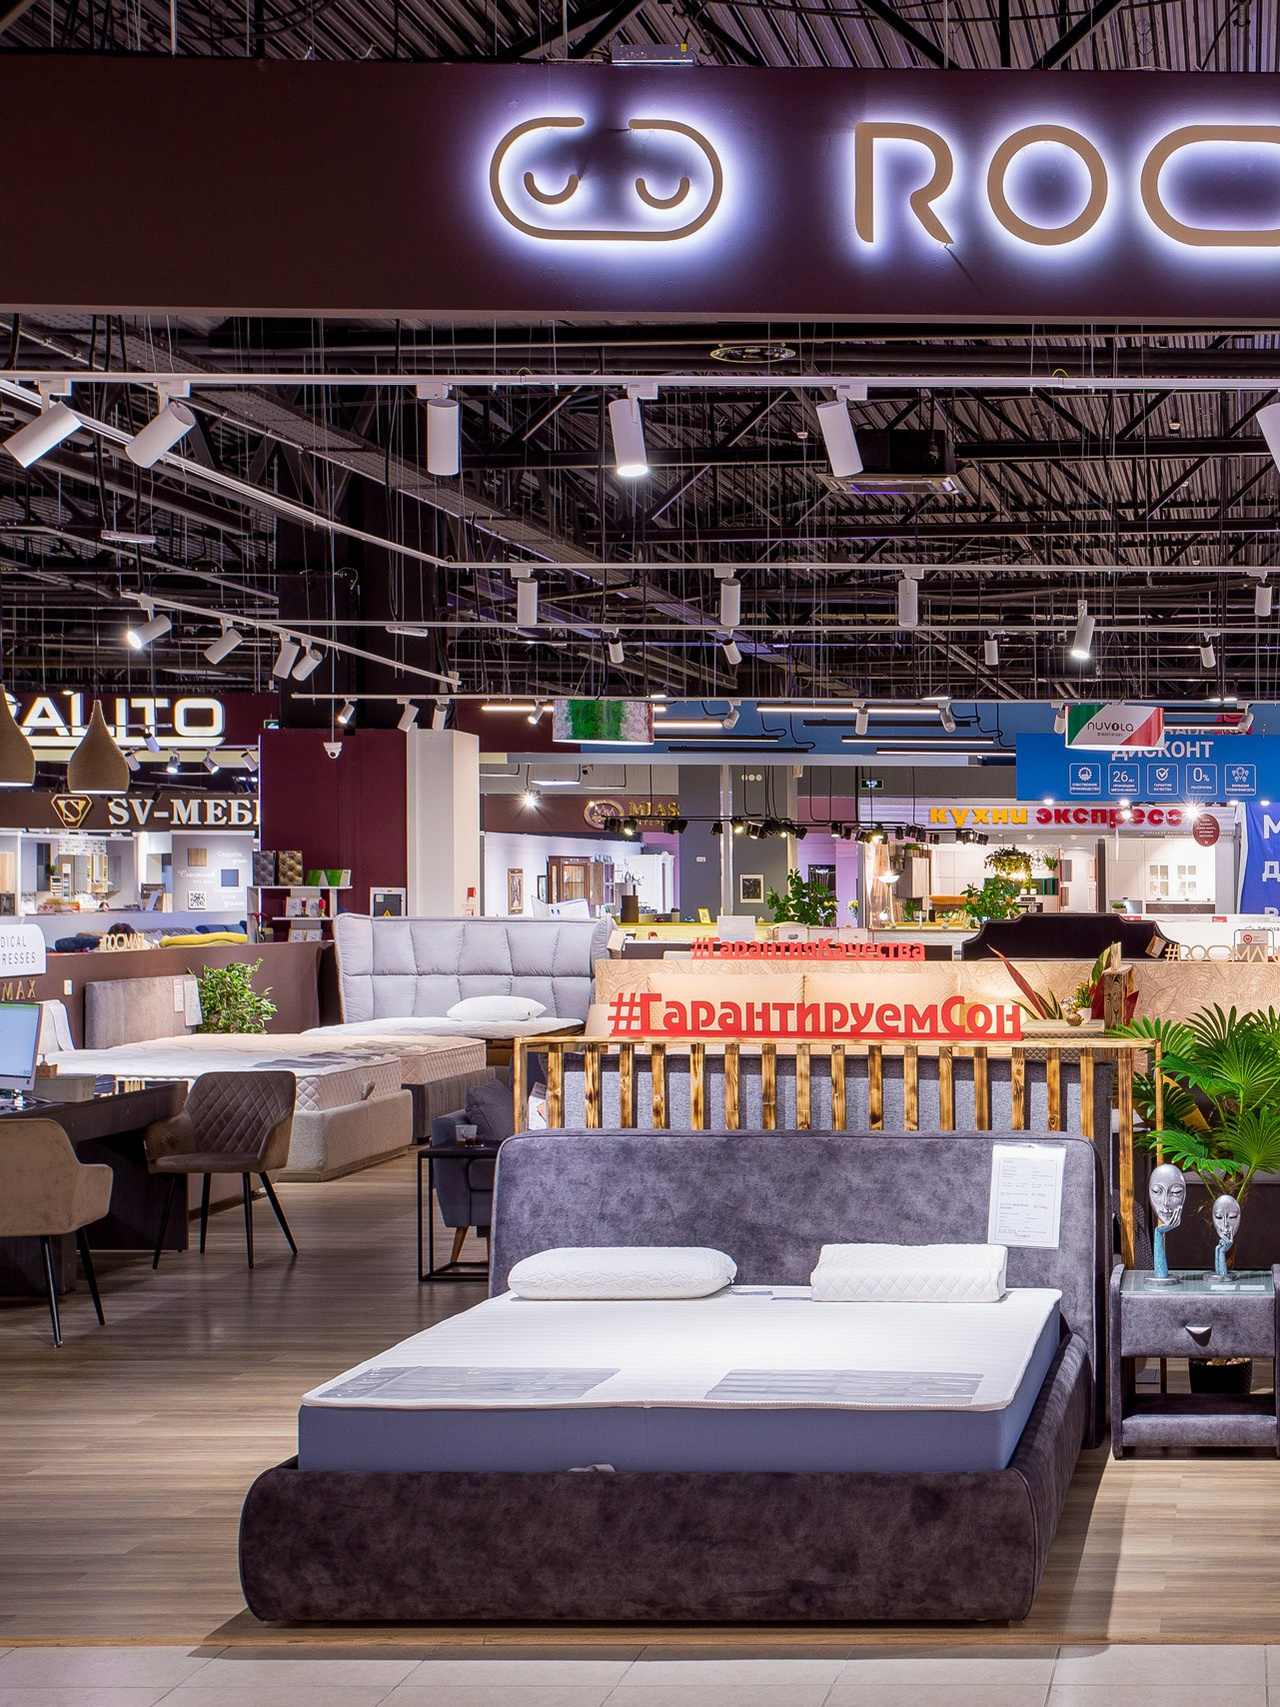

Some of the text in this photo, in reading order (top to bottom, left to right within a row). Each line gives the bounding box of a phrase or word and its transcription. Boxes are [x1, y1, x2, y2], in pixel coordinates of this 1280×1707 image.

[1113, 770, 1128, 782] 26
[929, 807, 1027, 828] кухни
[1036, 808, 1183, 828] экспресс
[691, 936, 926, 960] #ГарантияКачества
[607, 991, 1023, 1037] #ГарантируемСон
